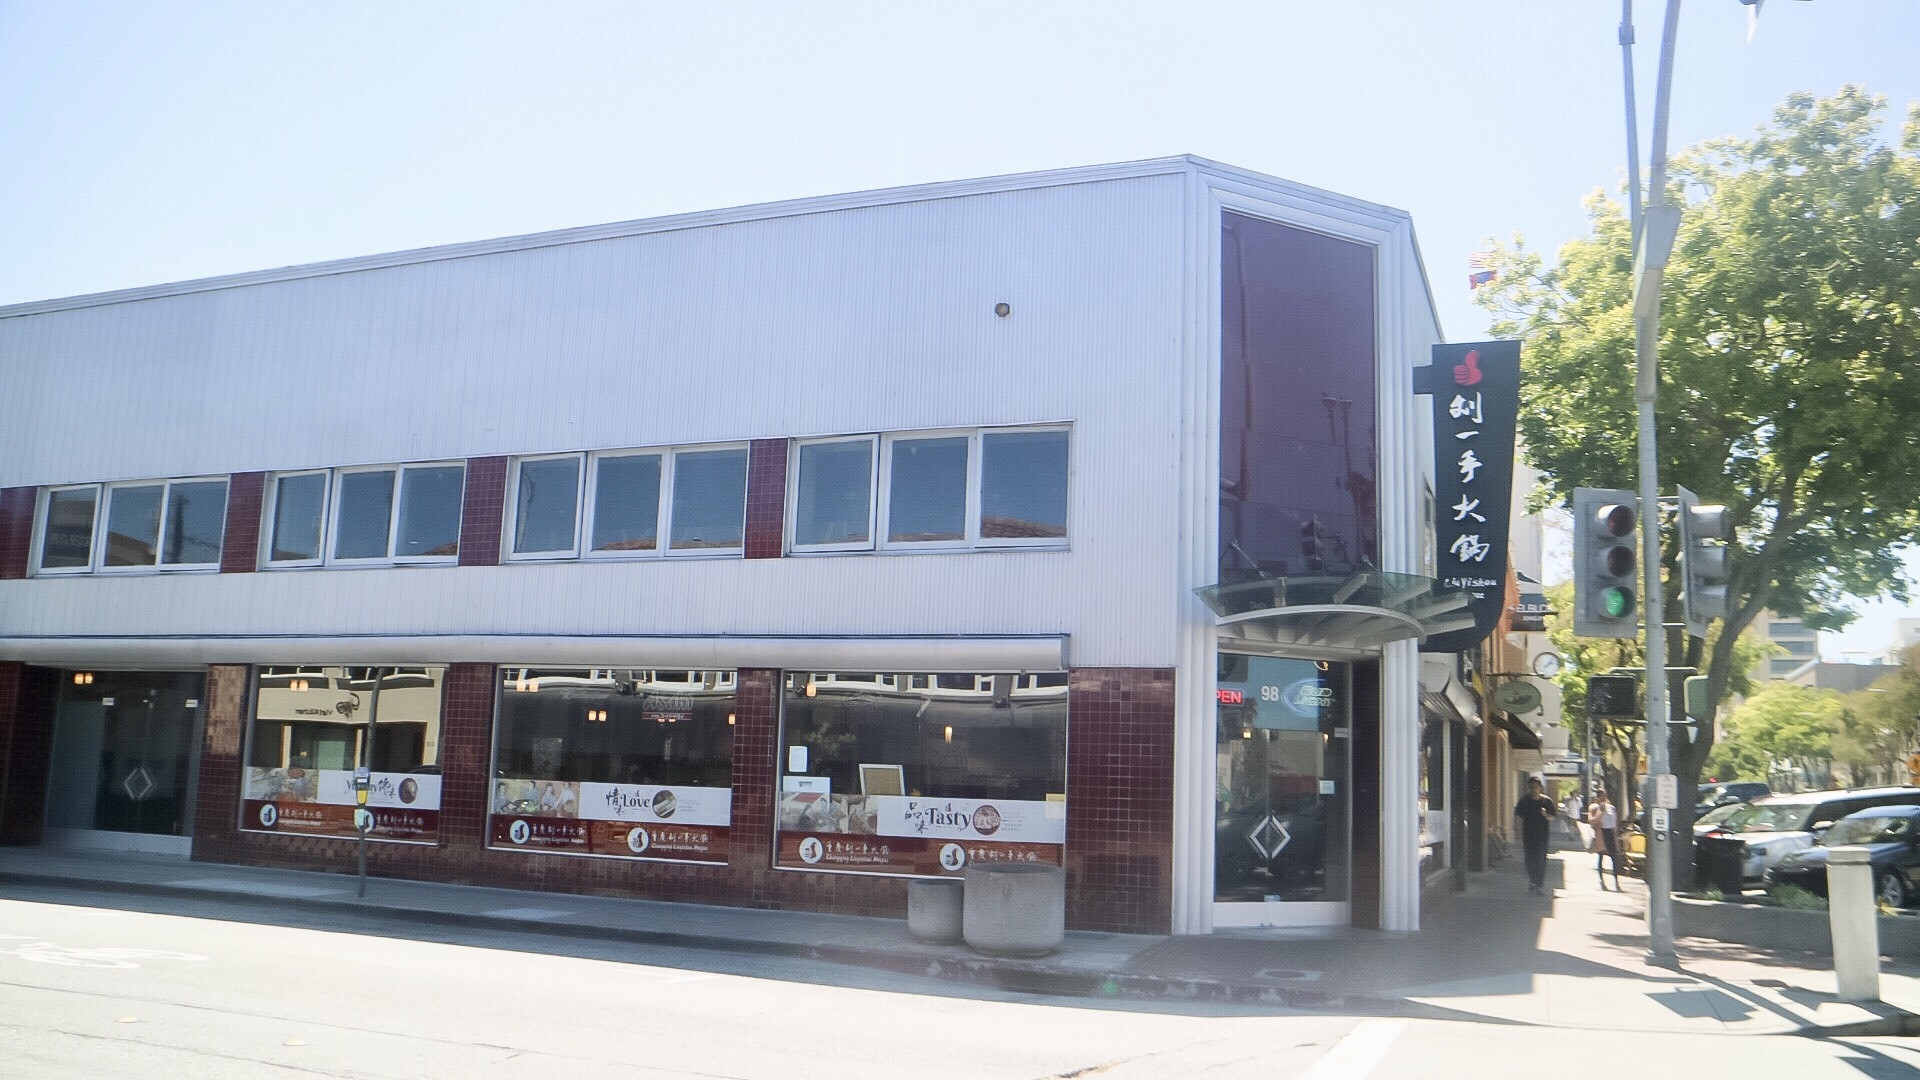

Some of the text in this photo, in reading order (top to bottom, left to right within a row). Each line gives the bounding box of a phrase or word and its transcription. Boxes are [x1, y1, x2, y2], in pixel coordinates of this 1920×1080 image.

[1216, 689, 1243, 704] PEN
[1260, 685, 1280, 702] 98
[620, 793, 651, 808] Love
[924, 807, 972, 831] Tasty
